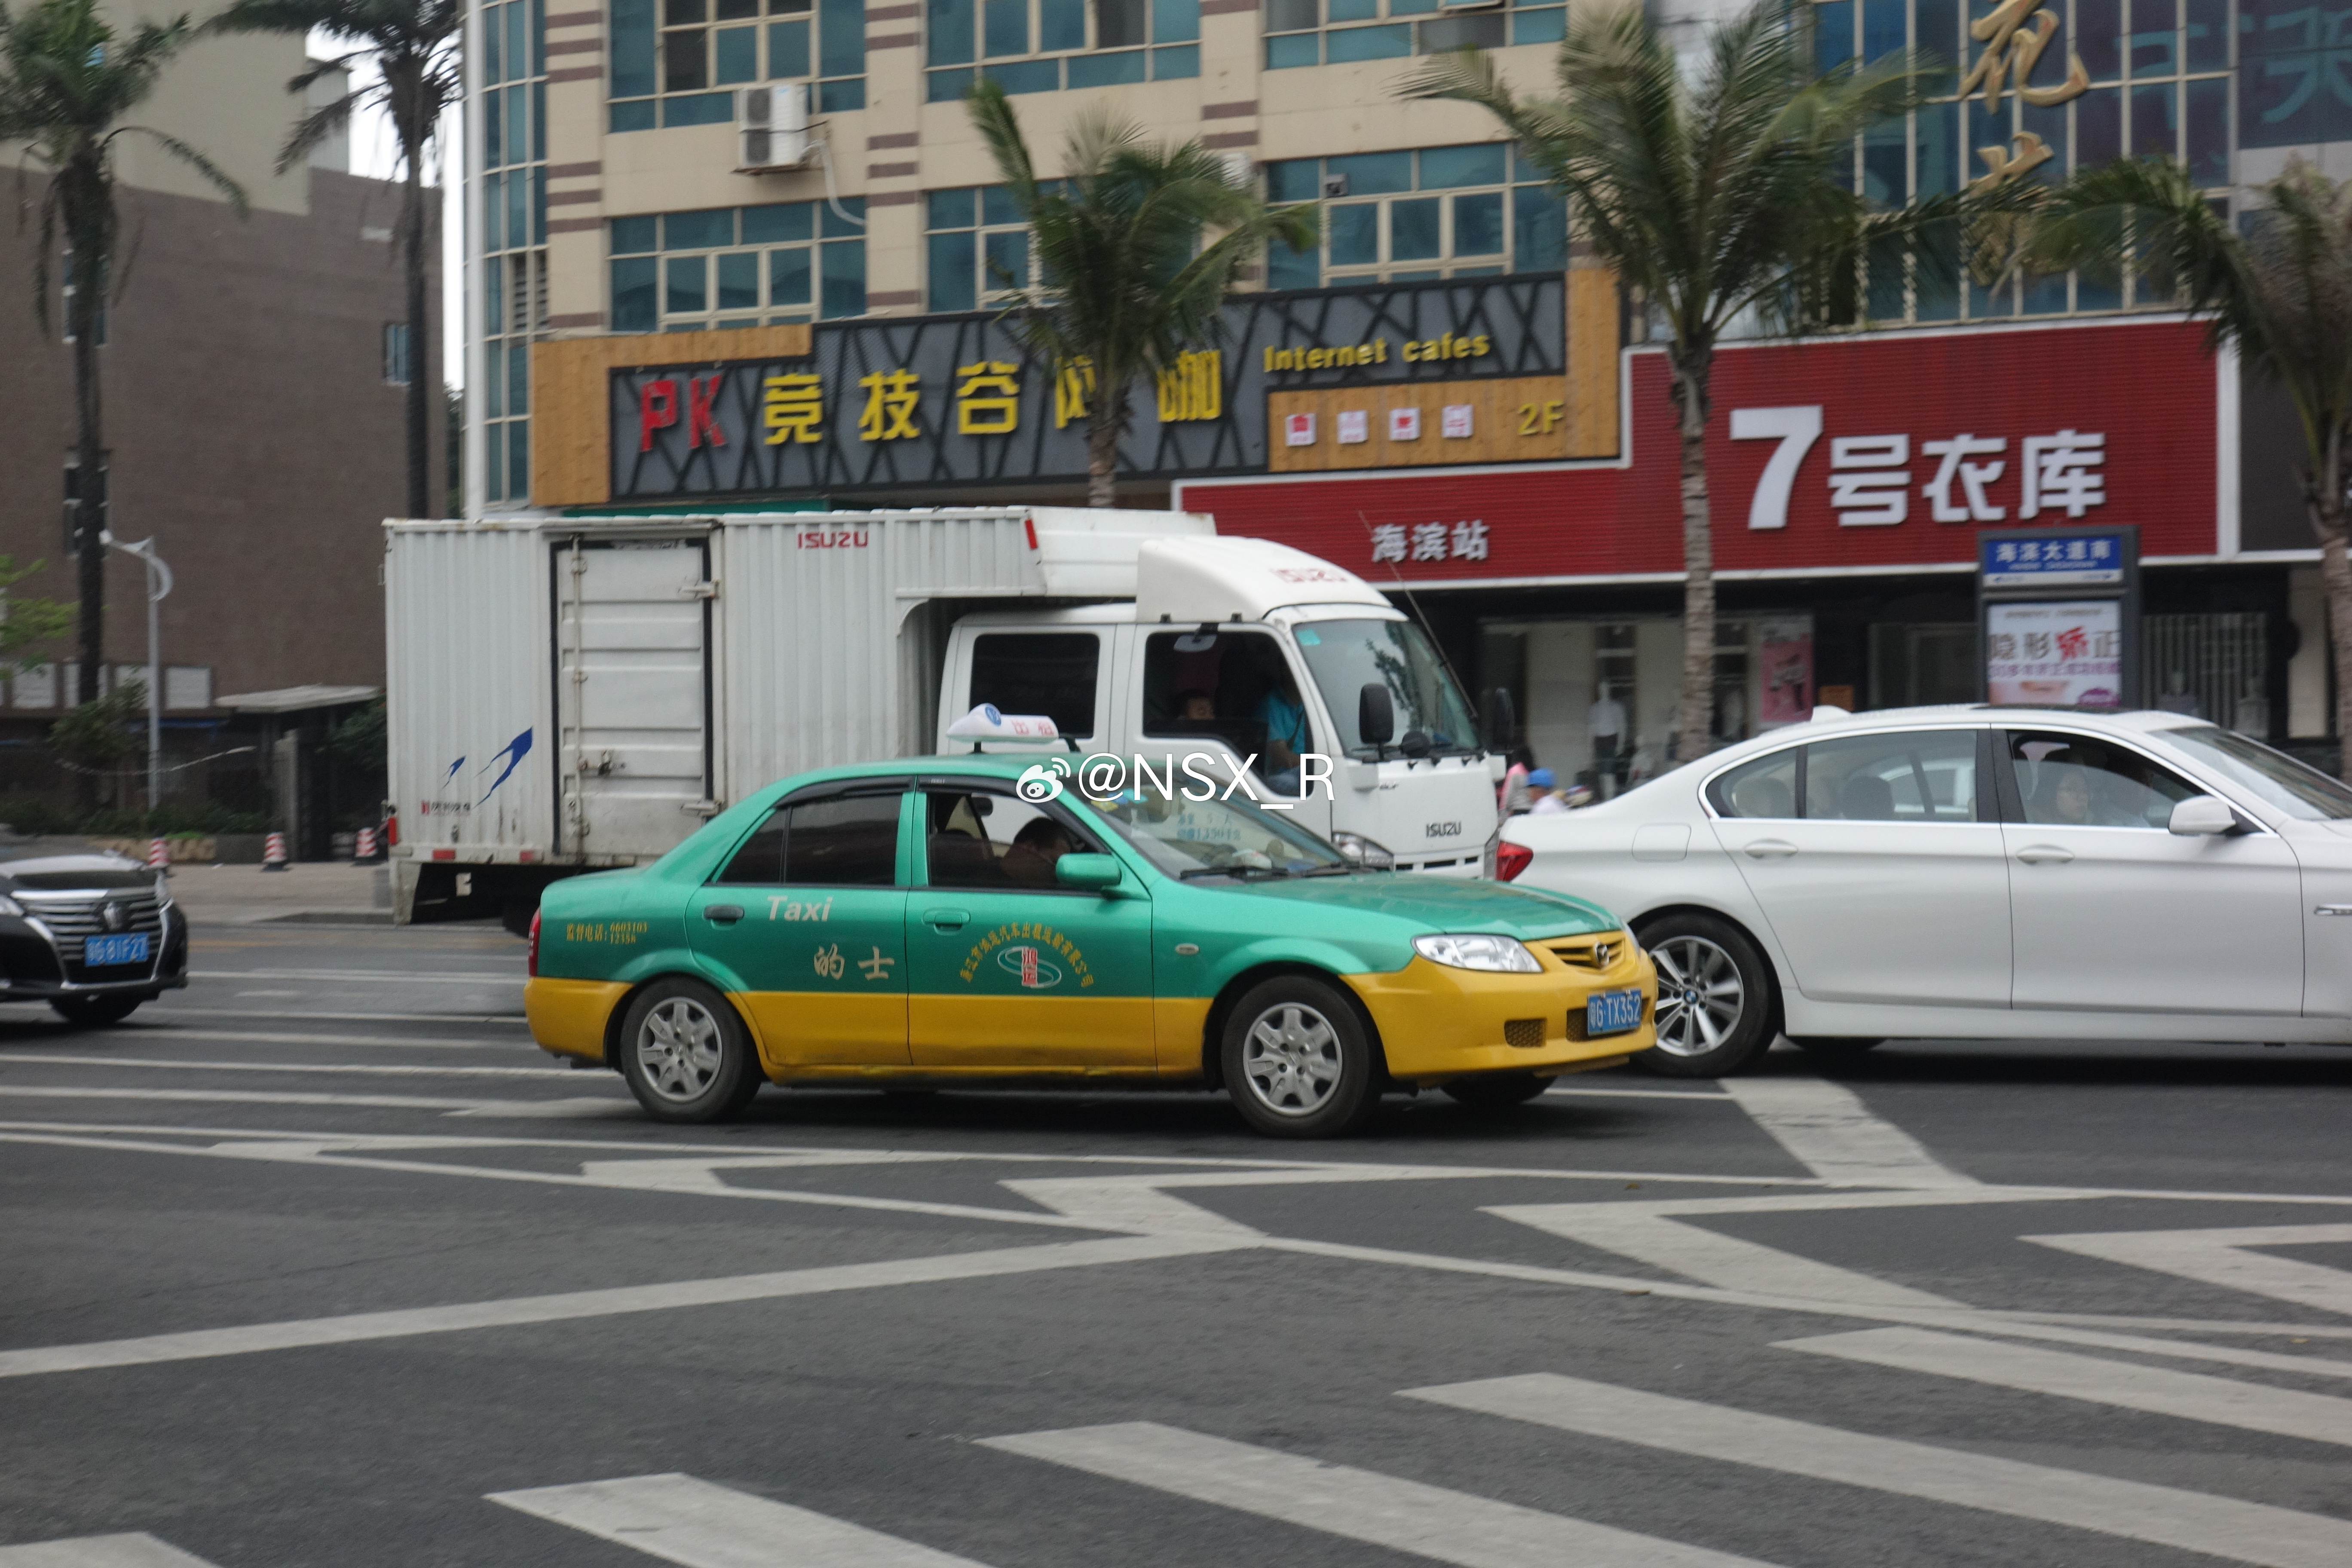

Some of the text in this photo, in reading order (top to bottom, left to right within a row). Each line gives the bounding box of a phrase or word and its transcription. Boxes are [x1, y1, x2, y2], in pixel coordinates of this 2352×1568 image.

[1263, 335, 1489, 372] Internet cafes
[640, 375, 727, 452] PK
[1517, 400, 1565, 435] 2F
[1729, 404, 2106, 530] 7号衣库
[797, 530, 868, 549] ISUZU
[1371, 519, 1490, 564] 海滨站
[1011, 719, 1054, 736] 出租
[1426, 821, 1462, 838] ISUZU
[767, 895, 833, 922] Taxi
[813, 943, 895, 980] 的士
